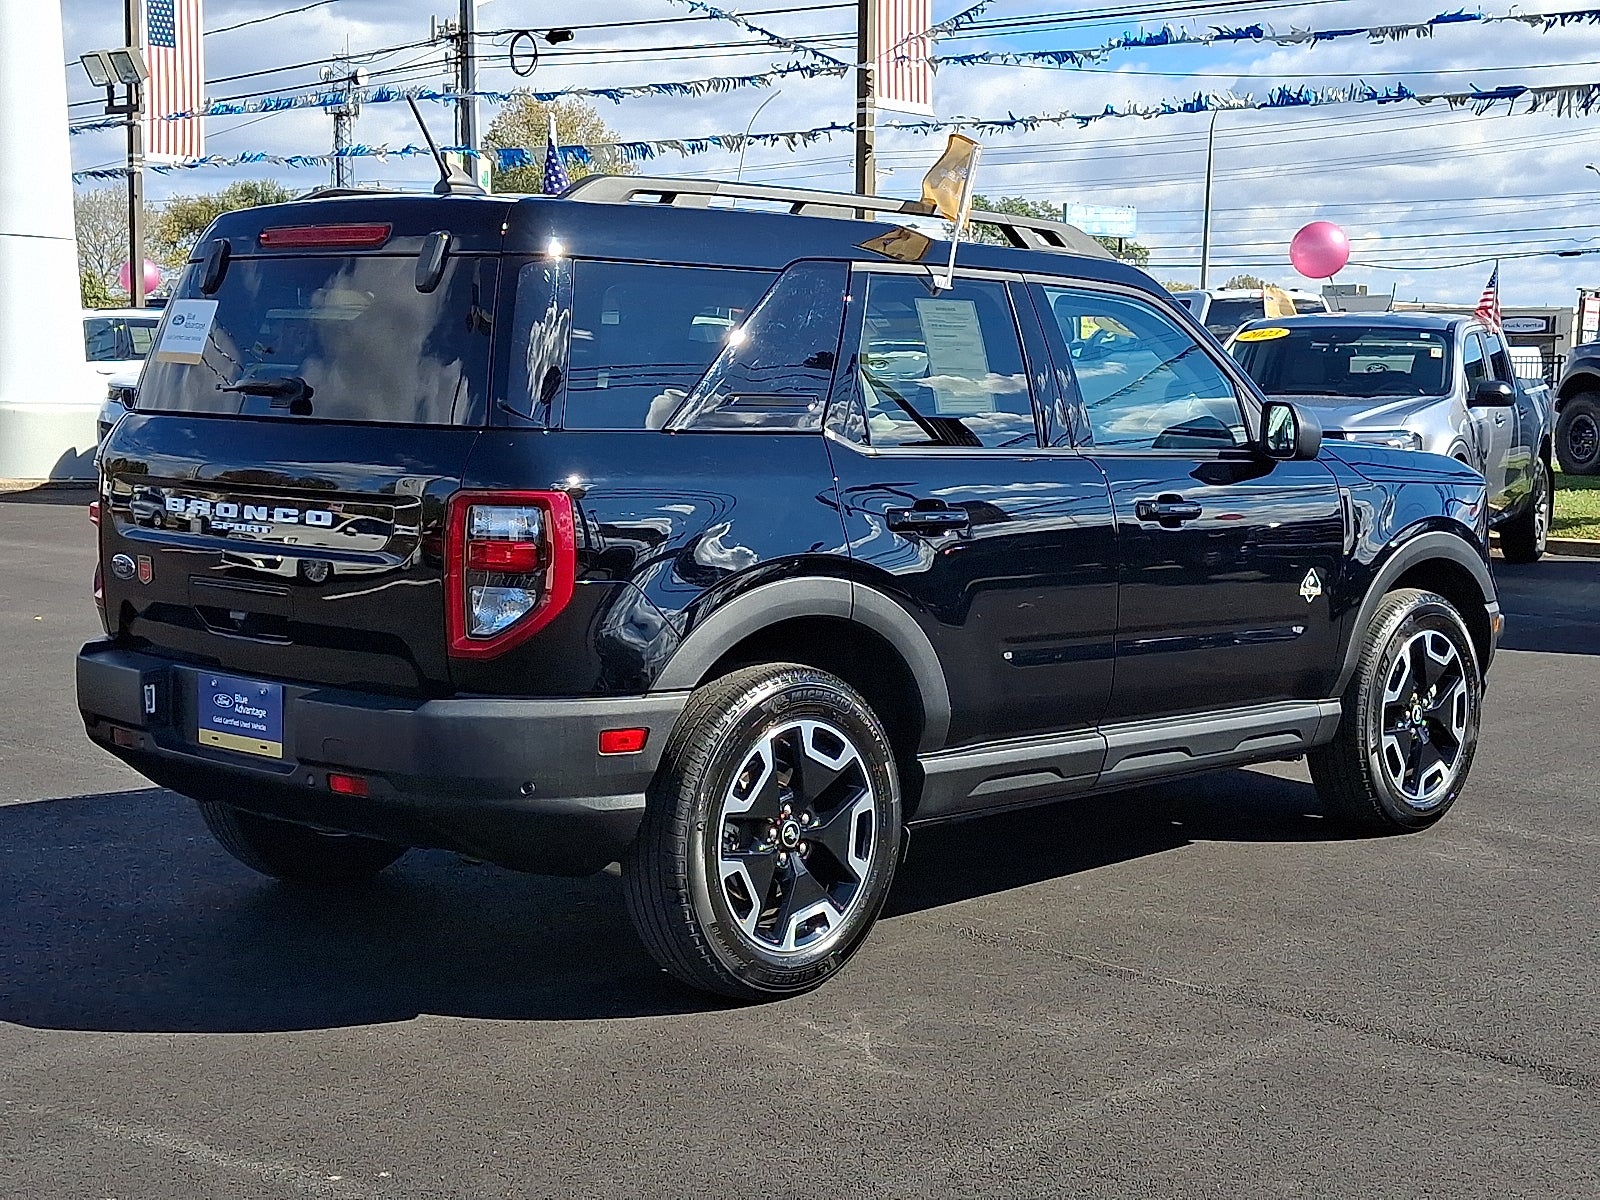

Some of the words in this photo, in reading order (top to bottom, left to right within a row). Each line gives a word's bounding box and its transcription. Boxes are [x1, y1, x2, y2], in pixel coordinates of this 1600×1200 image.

[166, 498, 332, 526] BRONCO
[210, 521, 274, 534] SPORT
[235, 694, 248, 704] Blue
[791, 689, 851, 712] MICHELIN
[235, 704, 267, 718] Advantage
[213, 716, 223, 724] Gold
[855, 710, 881, 742] PRIMACY
